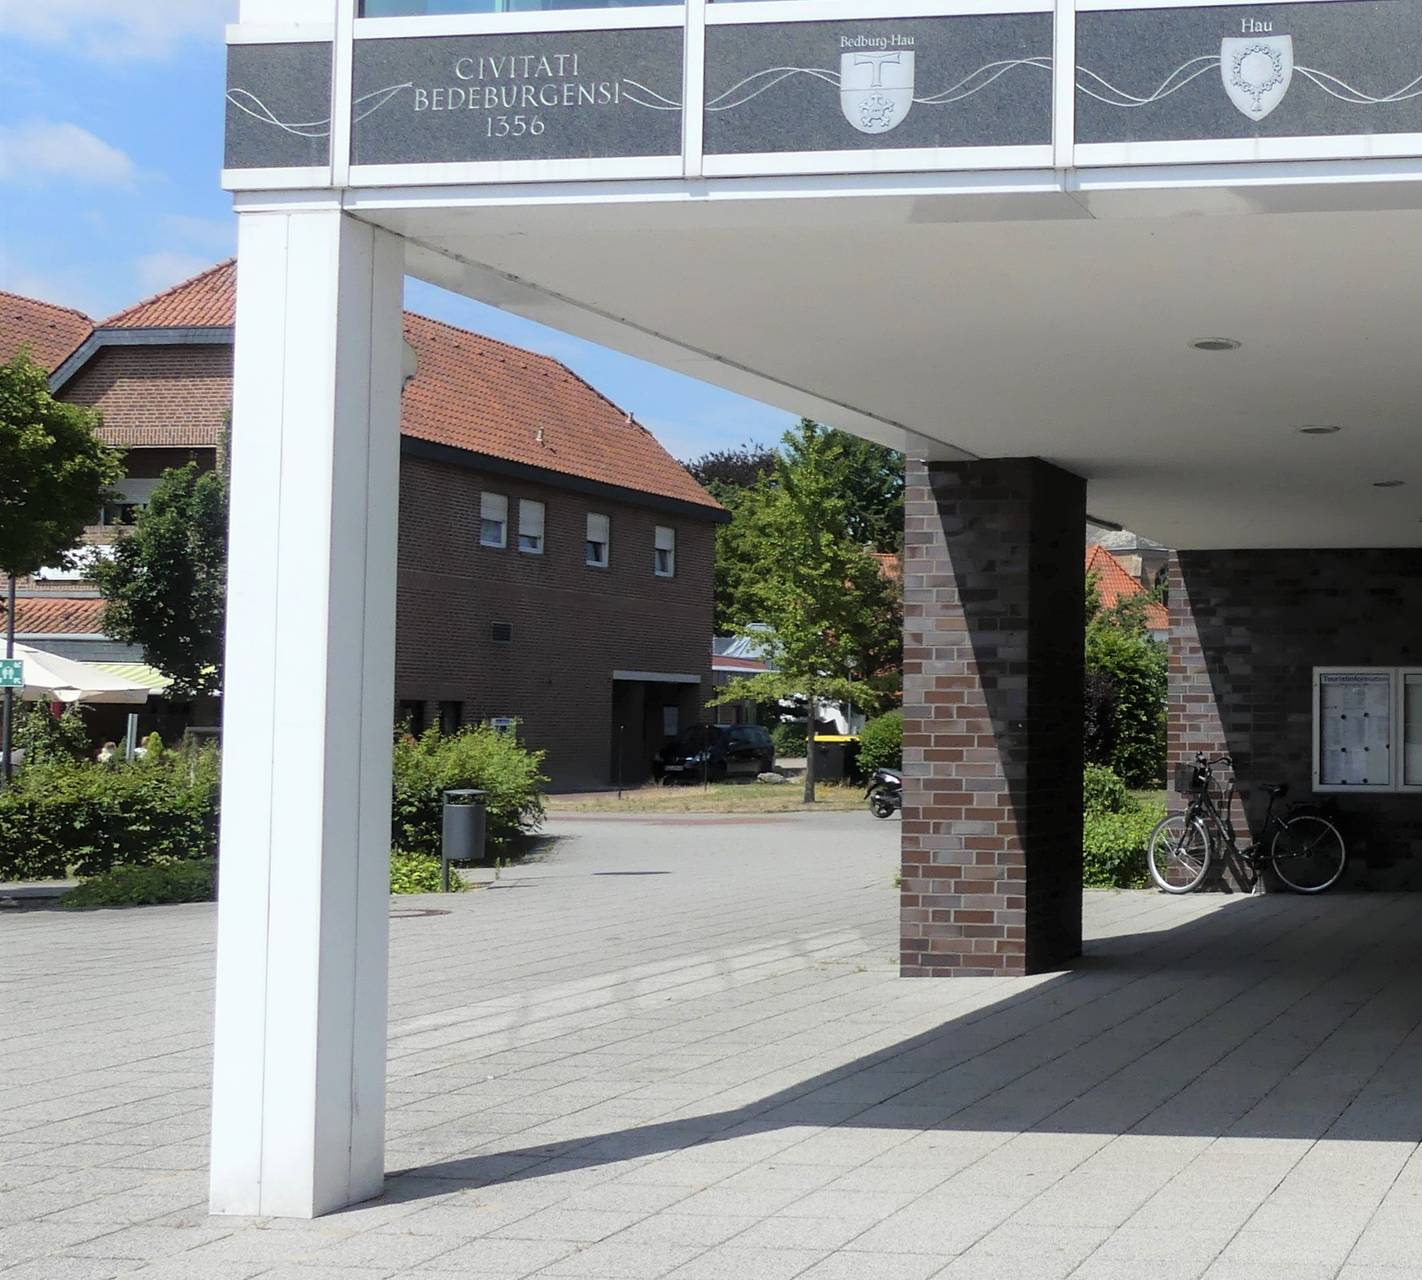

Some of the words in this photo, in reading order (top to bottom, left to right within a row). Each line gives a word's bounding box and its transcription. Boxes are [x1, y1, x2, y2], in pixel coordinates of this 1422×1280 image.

[1240, 17, 1273, 33] Hau
[840, 35, 916, 51] Bedburg-Hau
[455, 53, 579, 80] CIVITATI
[414, 79, 621, 111] BEDEBURGENSI
[486, 114, 546, 137] 1356
